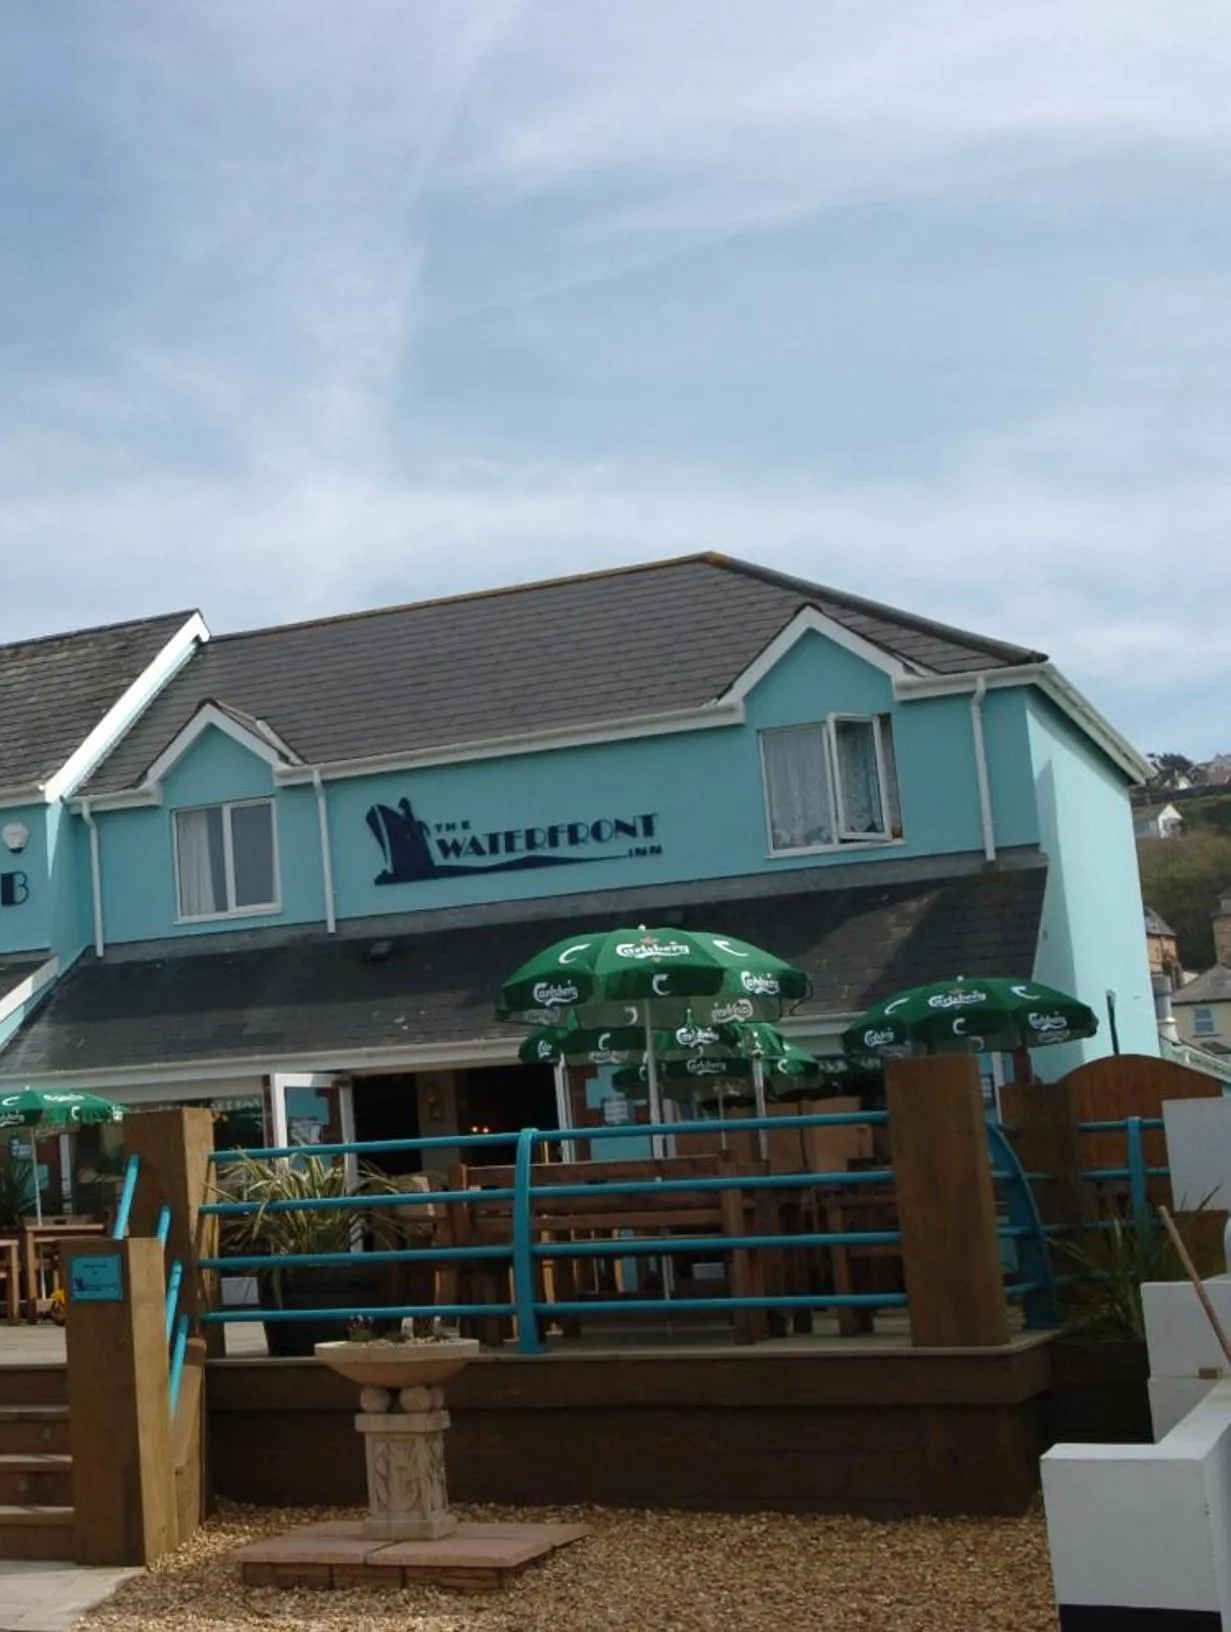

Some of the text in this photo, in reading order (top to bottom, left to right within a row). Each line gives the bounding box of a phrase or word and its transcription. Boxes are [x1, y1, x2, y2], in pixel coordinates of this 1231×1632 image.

[434, 820, 471, 833] THE
[436, 812, 658, 860] WATERFRONT
[628, 844, 663, 858] INN
[616, 942, 690, 959] Carlsberg
[534, 979, 578, 1006] Carlsberg
[928, 990, 987, 1008] Carlsberg
